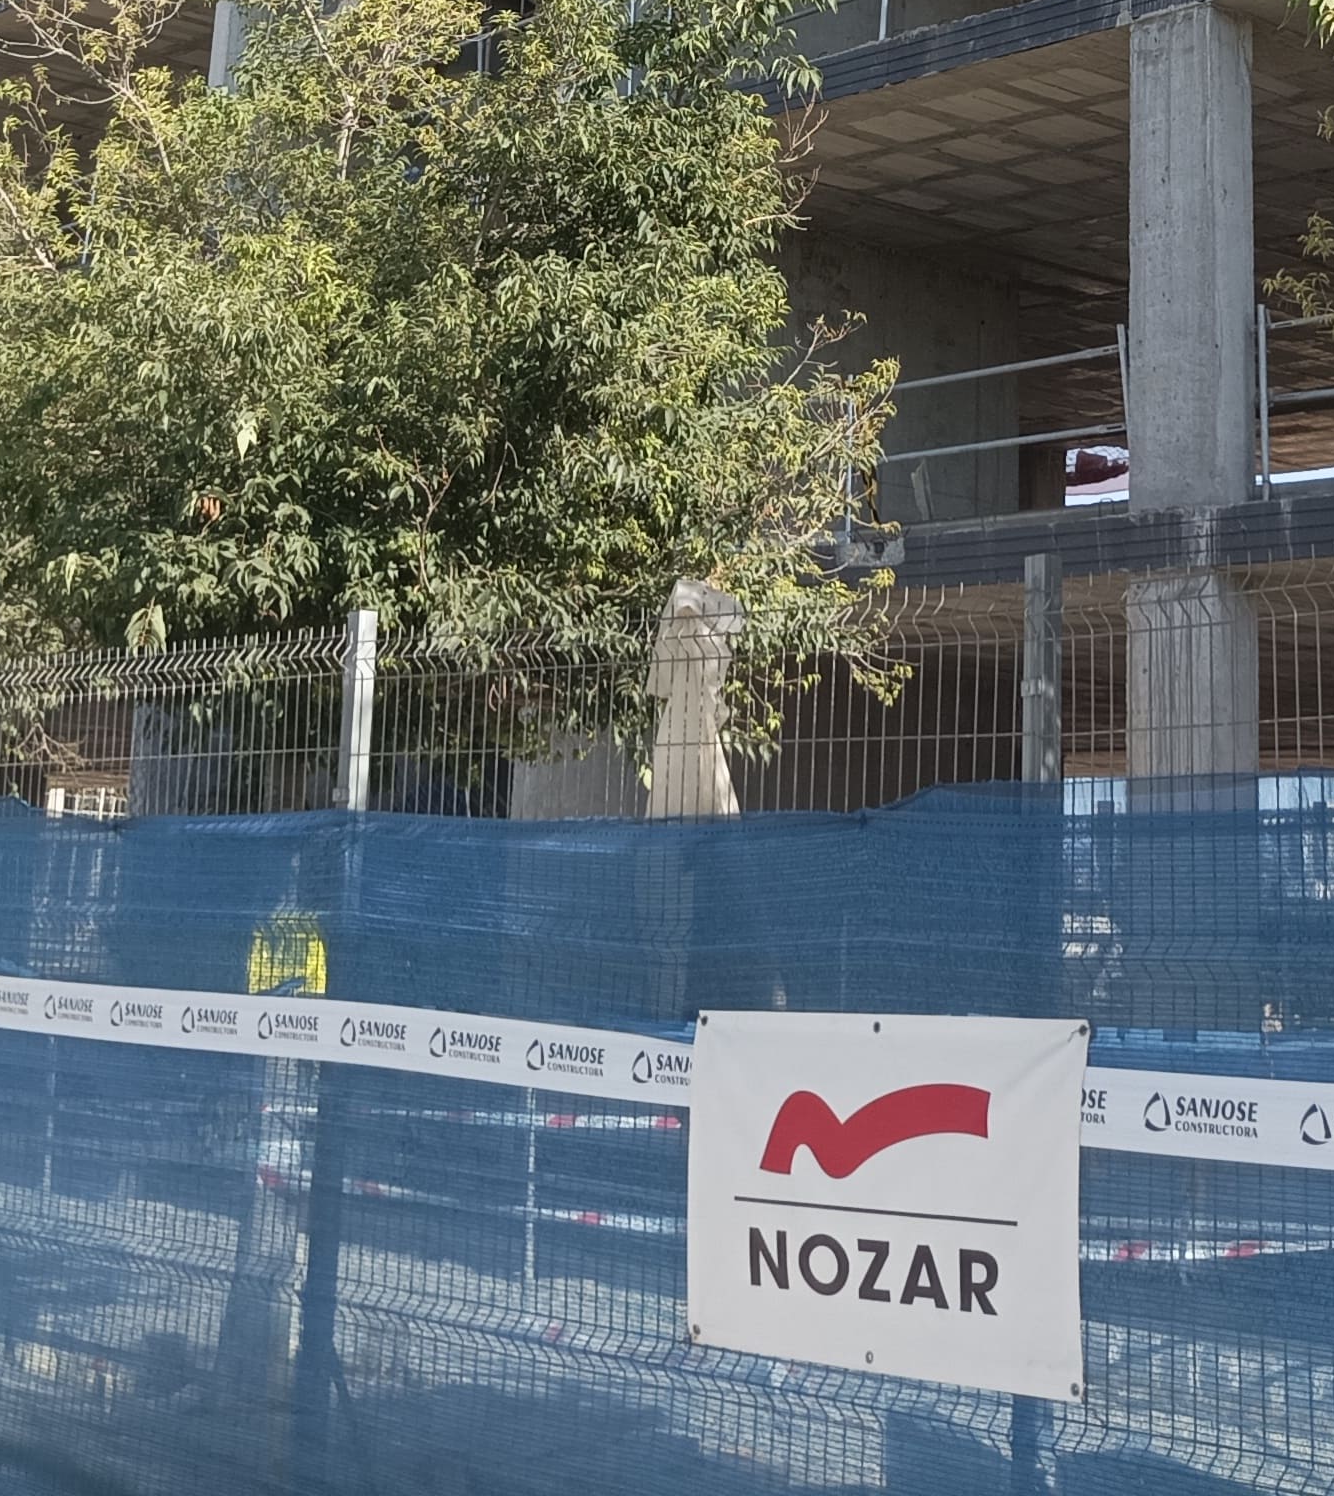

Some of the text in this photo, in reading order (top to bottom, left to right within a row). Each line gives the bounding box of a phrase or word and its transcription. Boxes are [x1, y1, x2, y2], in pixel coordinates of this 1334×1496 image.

[58, 996, 94, 1013] SANJOSE
[124, 1002, 163, 1019] SANJOSE
[197, 1008, 238, 1025] SANJOSE
[274, 1015, 319, 1031] SANJOSE
[359, 1020, 406, 1040] SANJOSE
[449, 1030, 502, 1052] SANJOSE
[449, 1048, 500, 1064] CONSTRUCTORA
[548, 1042, 605, 1065] SANJOSE
[547, 1062, 604, 1077] CONSTRUCTORA
[656, 1053, 692, 1074] SANJ
[655, 1073, 691, 1087] CONSTRU
[1175, 1095, 1258, 1123] SANJOSE
[1175, 1120, 1258, 1139] CONSTRUCTORA
[749, 1226, 999, 1316] NOZAR
